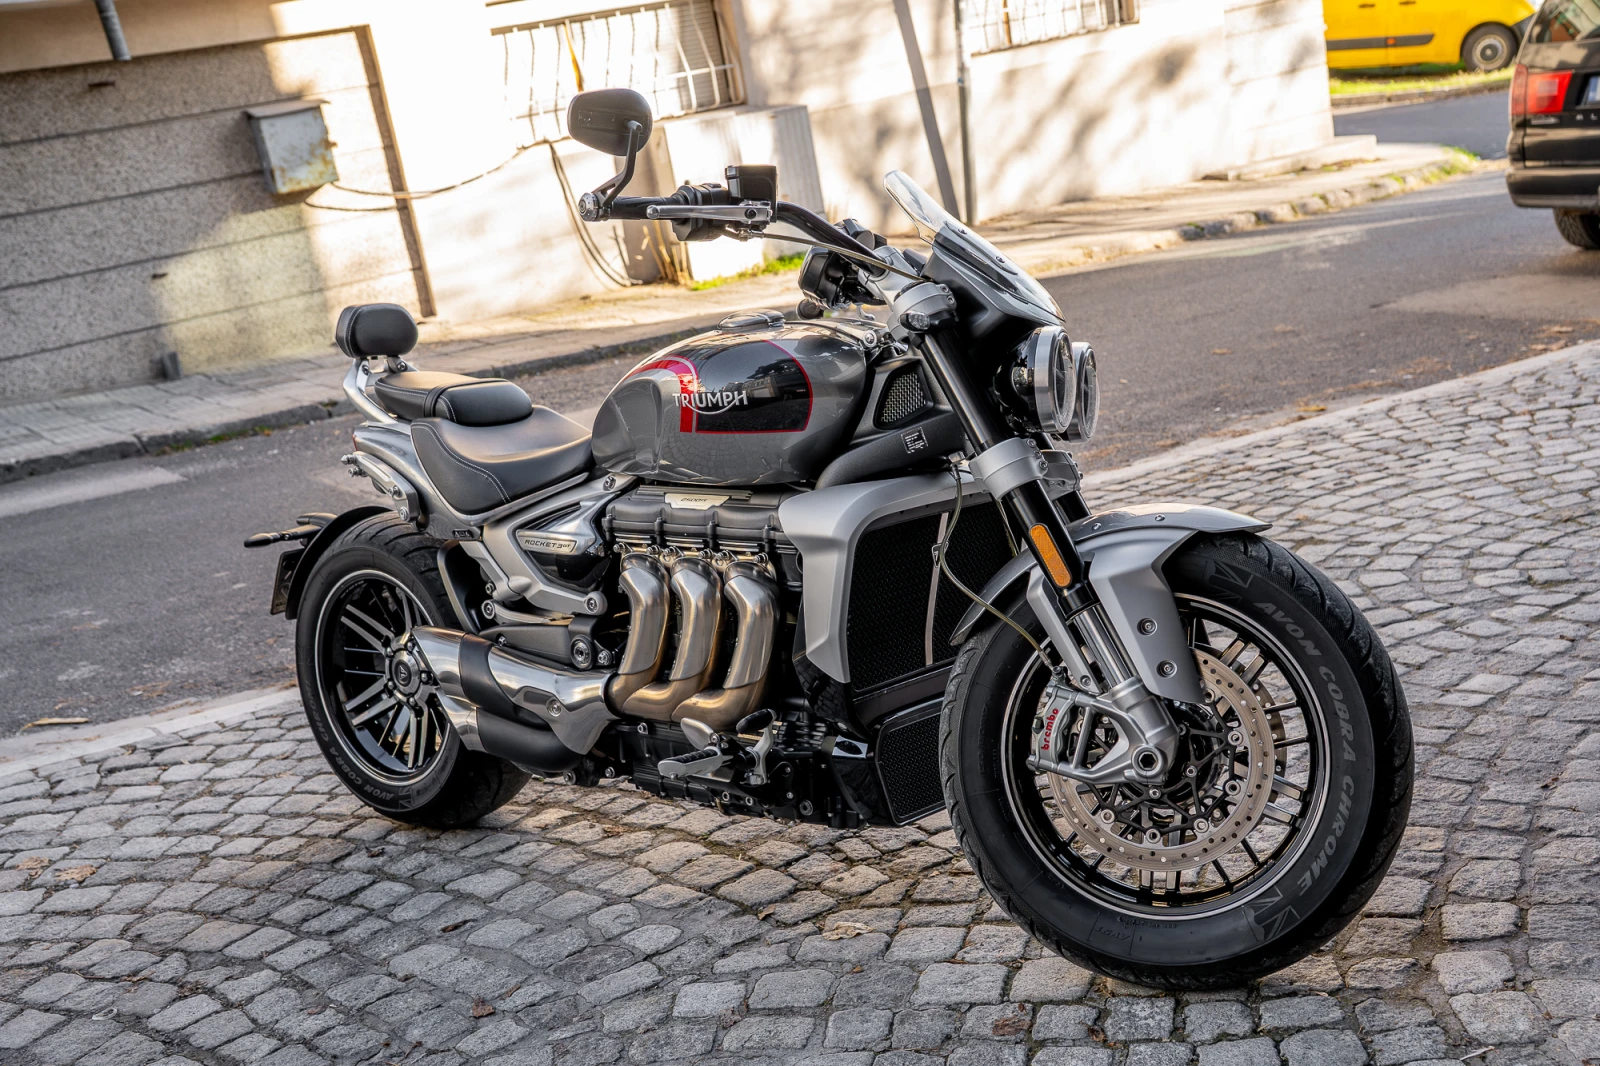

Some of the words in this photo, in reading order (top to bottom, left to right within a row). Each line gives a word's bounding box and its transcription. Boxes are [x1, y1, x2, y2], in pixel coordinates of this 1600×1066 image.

[672, 390, 748, 412] TRIUMPH
[1253, 602, 1322, 656] AVON
[1041, 708, 1059, 751] brembo
[1318, 665, 1356, 762] COBRA
[329, 746, 363, 785] COBRA
[363, 784, 395, 801] AVON
[1297, 775, 1355, 896] CHROME
